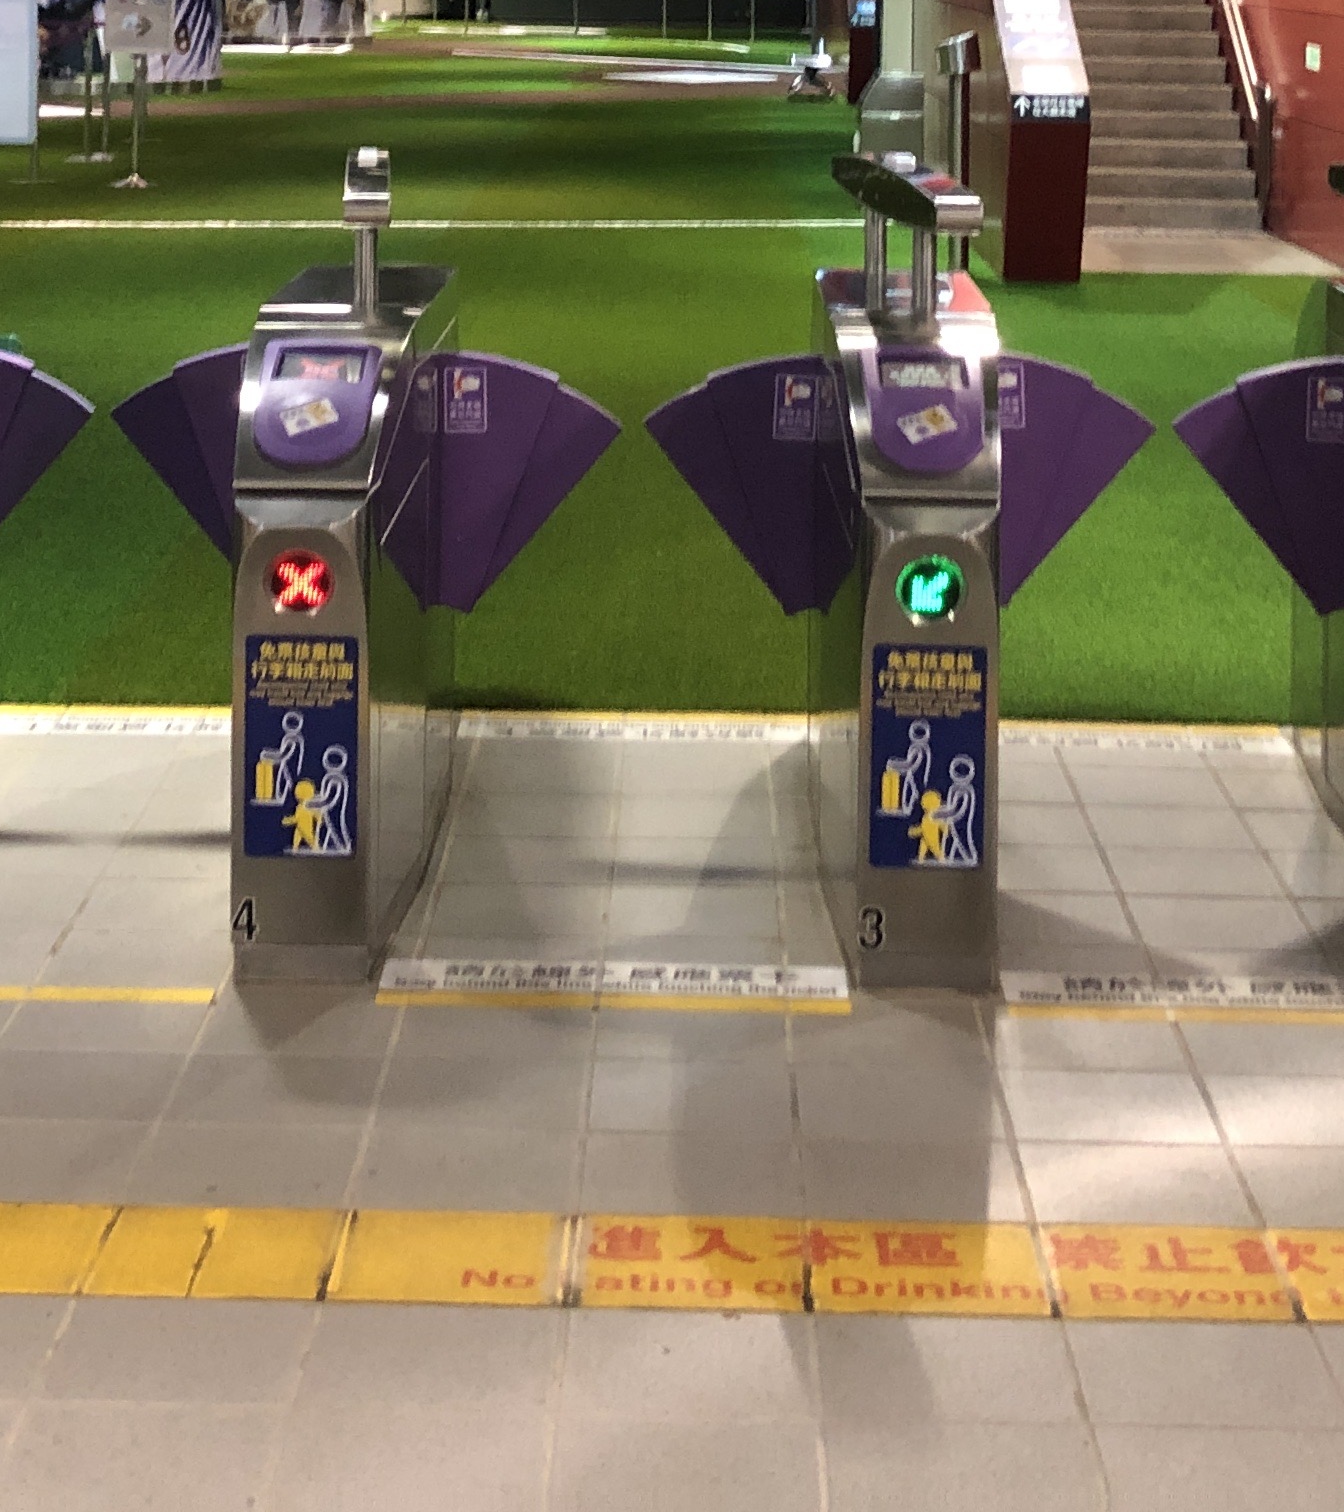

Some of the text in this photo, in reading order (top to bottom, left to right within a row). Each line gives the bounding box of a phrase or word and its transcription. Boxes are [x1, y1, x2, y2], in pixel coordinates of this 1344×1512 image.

[232, 898, 258, 940] 4
[859, 907, 883, 950] 3
[588, 1225, 962, 1268] 進入本區
[460, 1268, 536, 1289] No
[571, 1273, 733, 1299] ating
